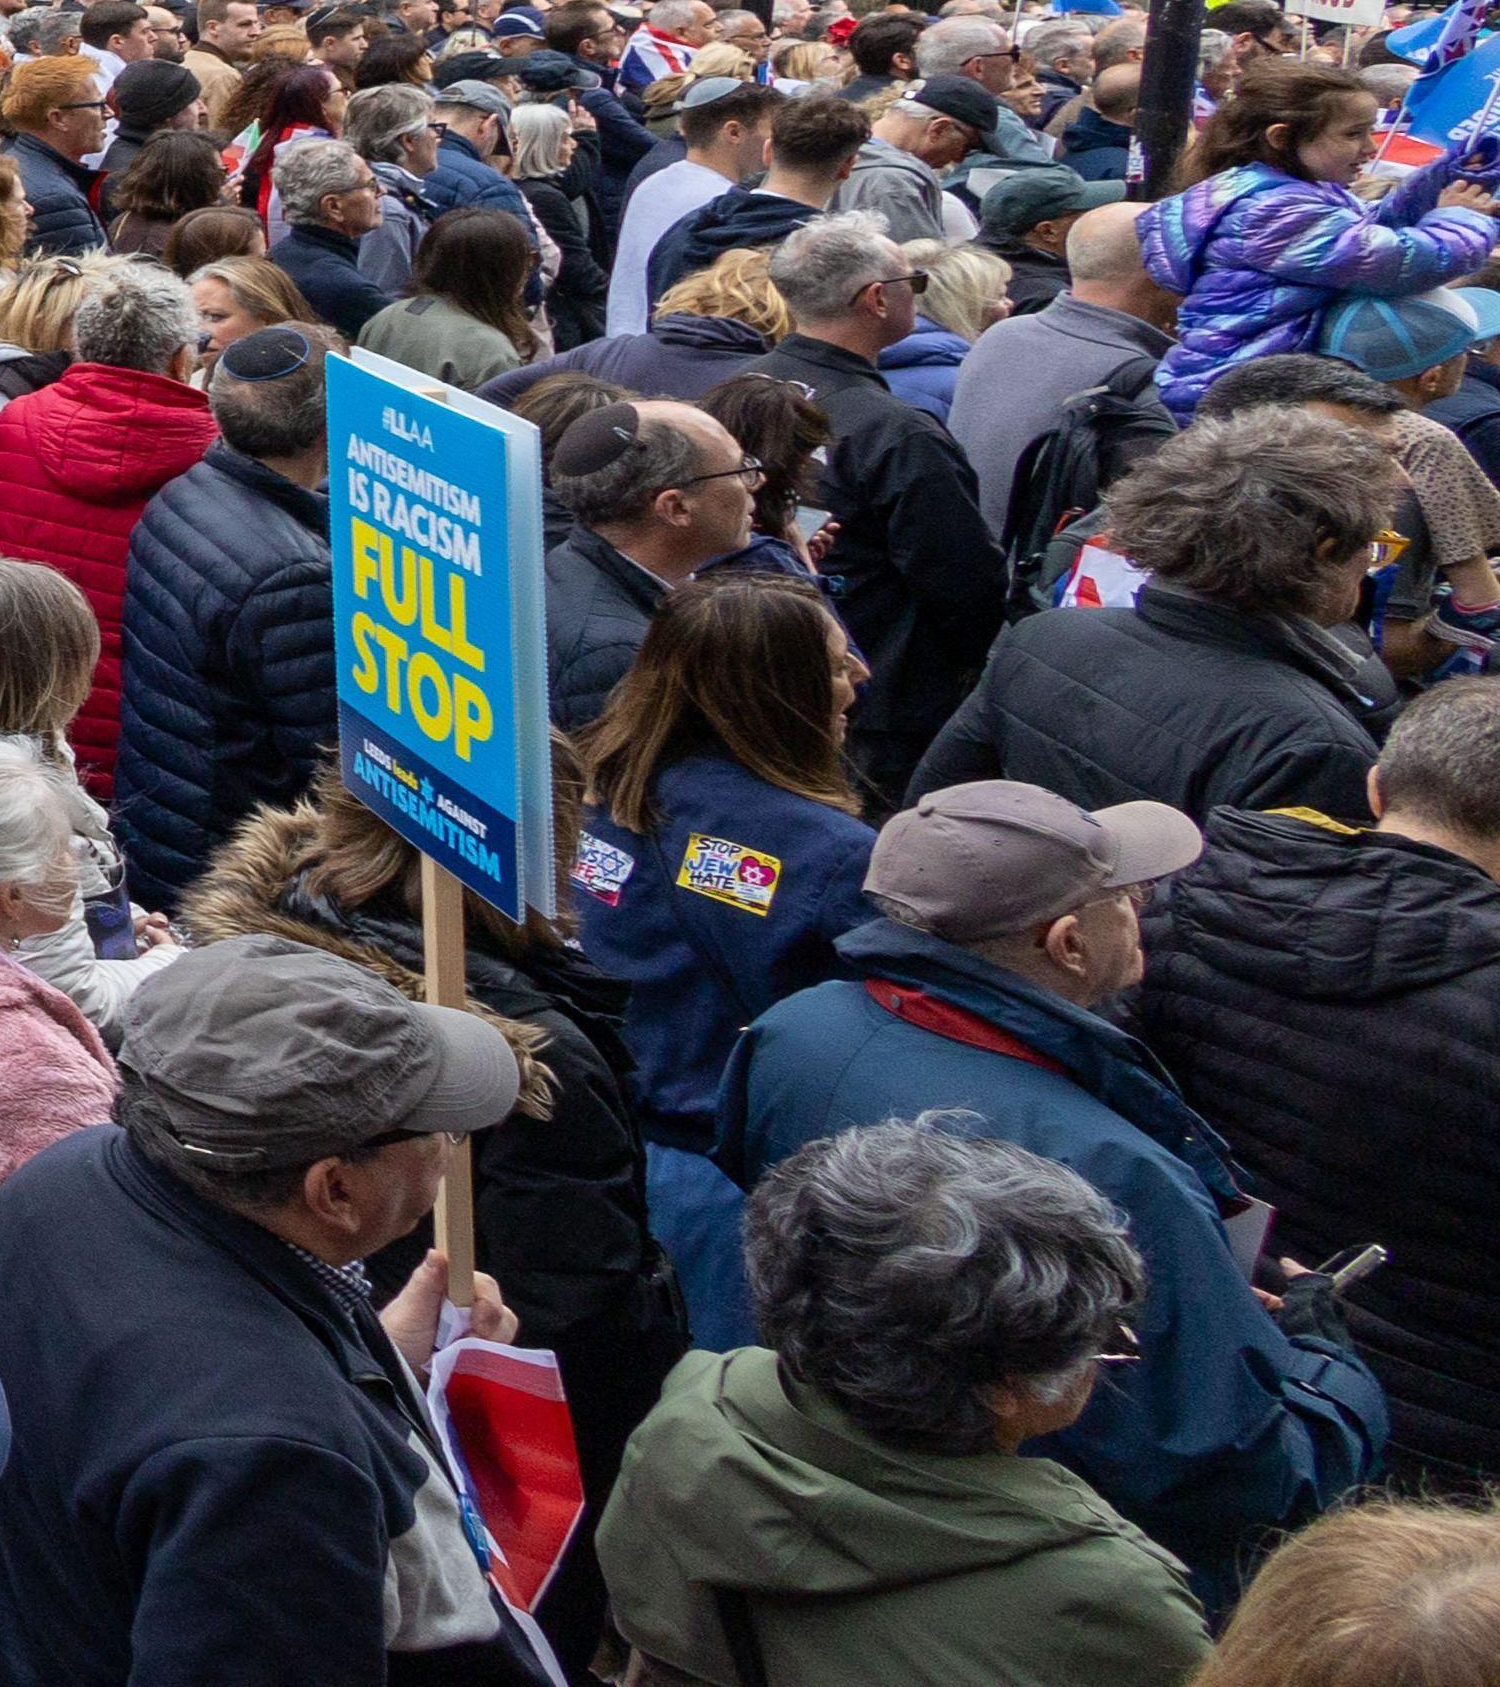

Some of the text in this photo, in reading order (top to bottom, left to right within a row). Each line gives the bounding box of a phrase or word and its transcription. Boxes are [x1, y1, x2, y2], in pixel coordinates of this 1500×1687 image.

[382, 405, 436, 454] #LLAA
[347, 432, 482, 527] ANTISEMITISM
[349, 466, 483, 577] IS RACISM
[351, 515, 485, 673] FULL
[352, 611, 494, 763] STOP
[353, 751, 502, 884] ANTISEMITISM
[363, 738, 392, 771] LEEDS
[437, 794, 489, 840] AGAINST
[687, 853, 739, 876] JEW
[689, 871, 736, 890] HATE
[695, 837, 742, 857] STOP
